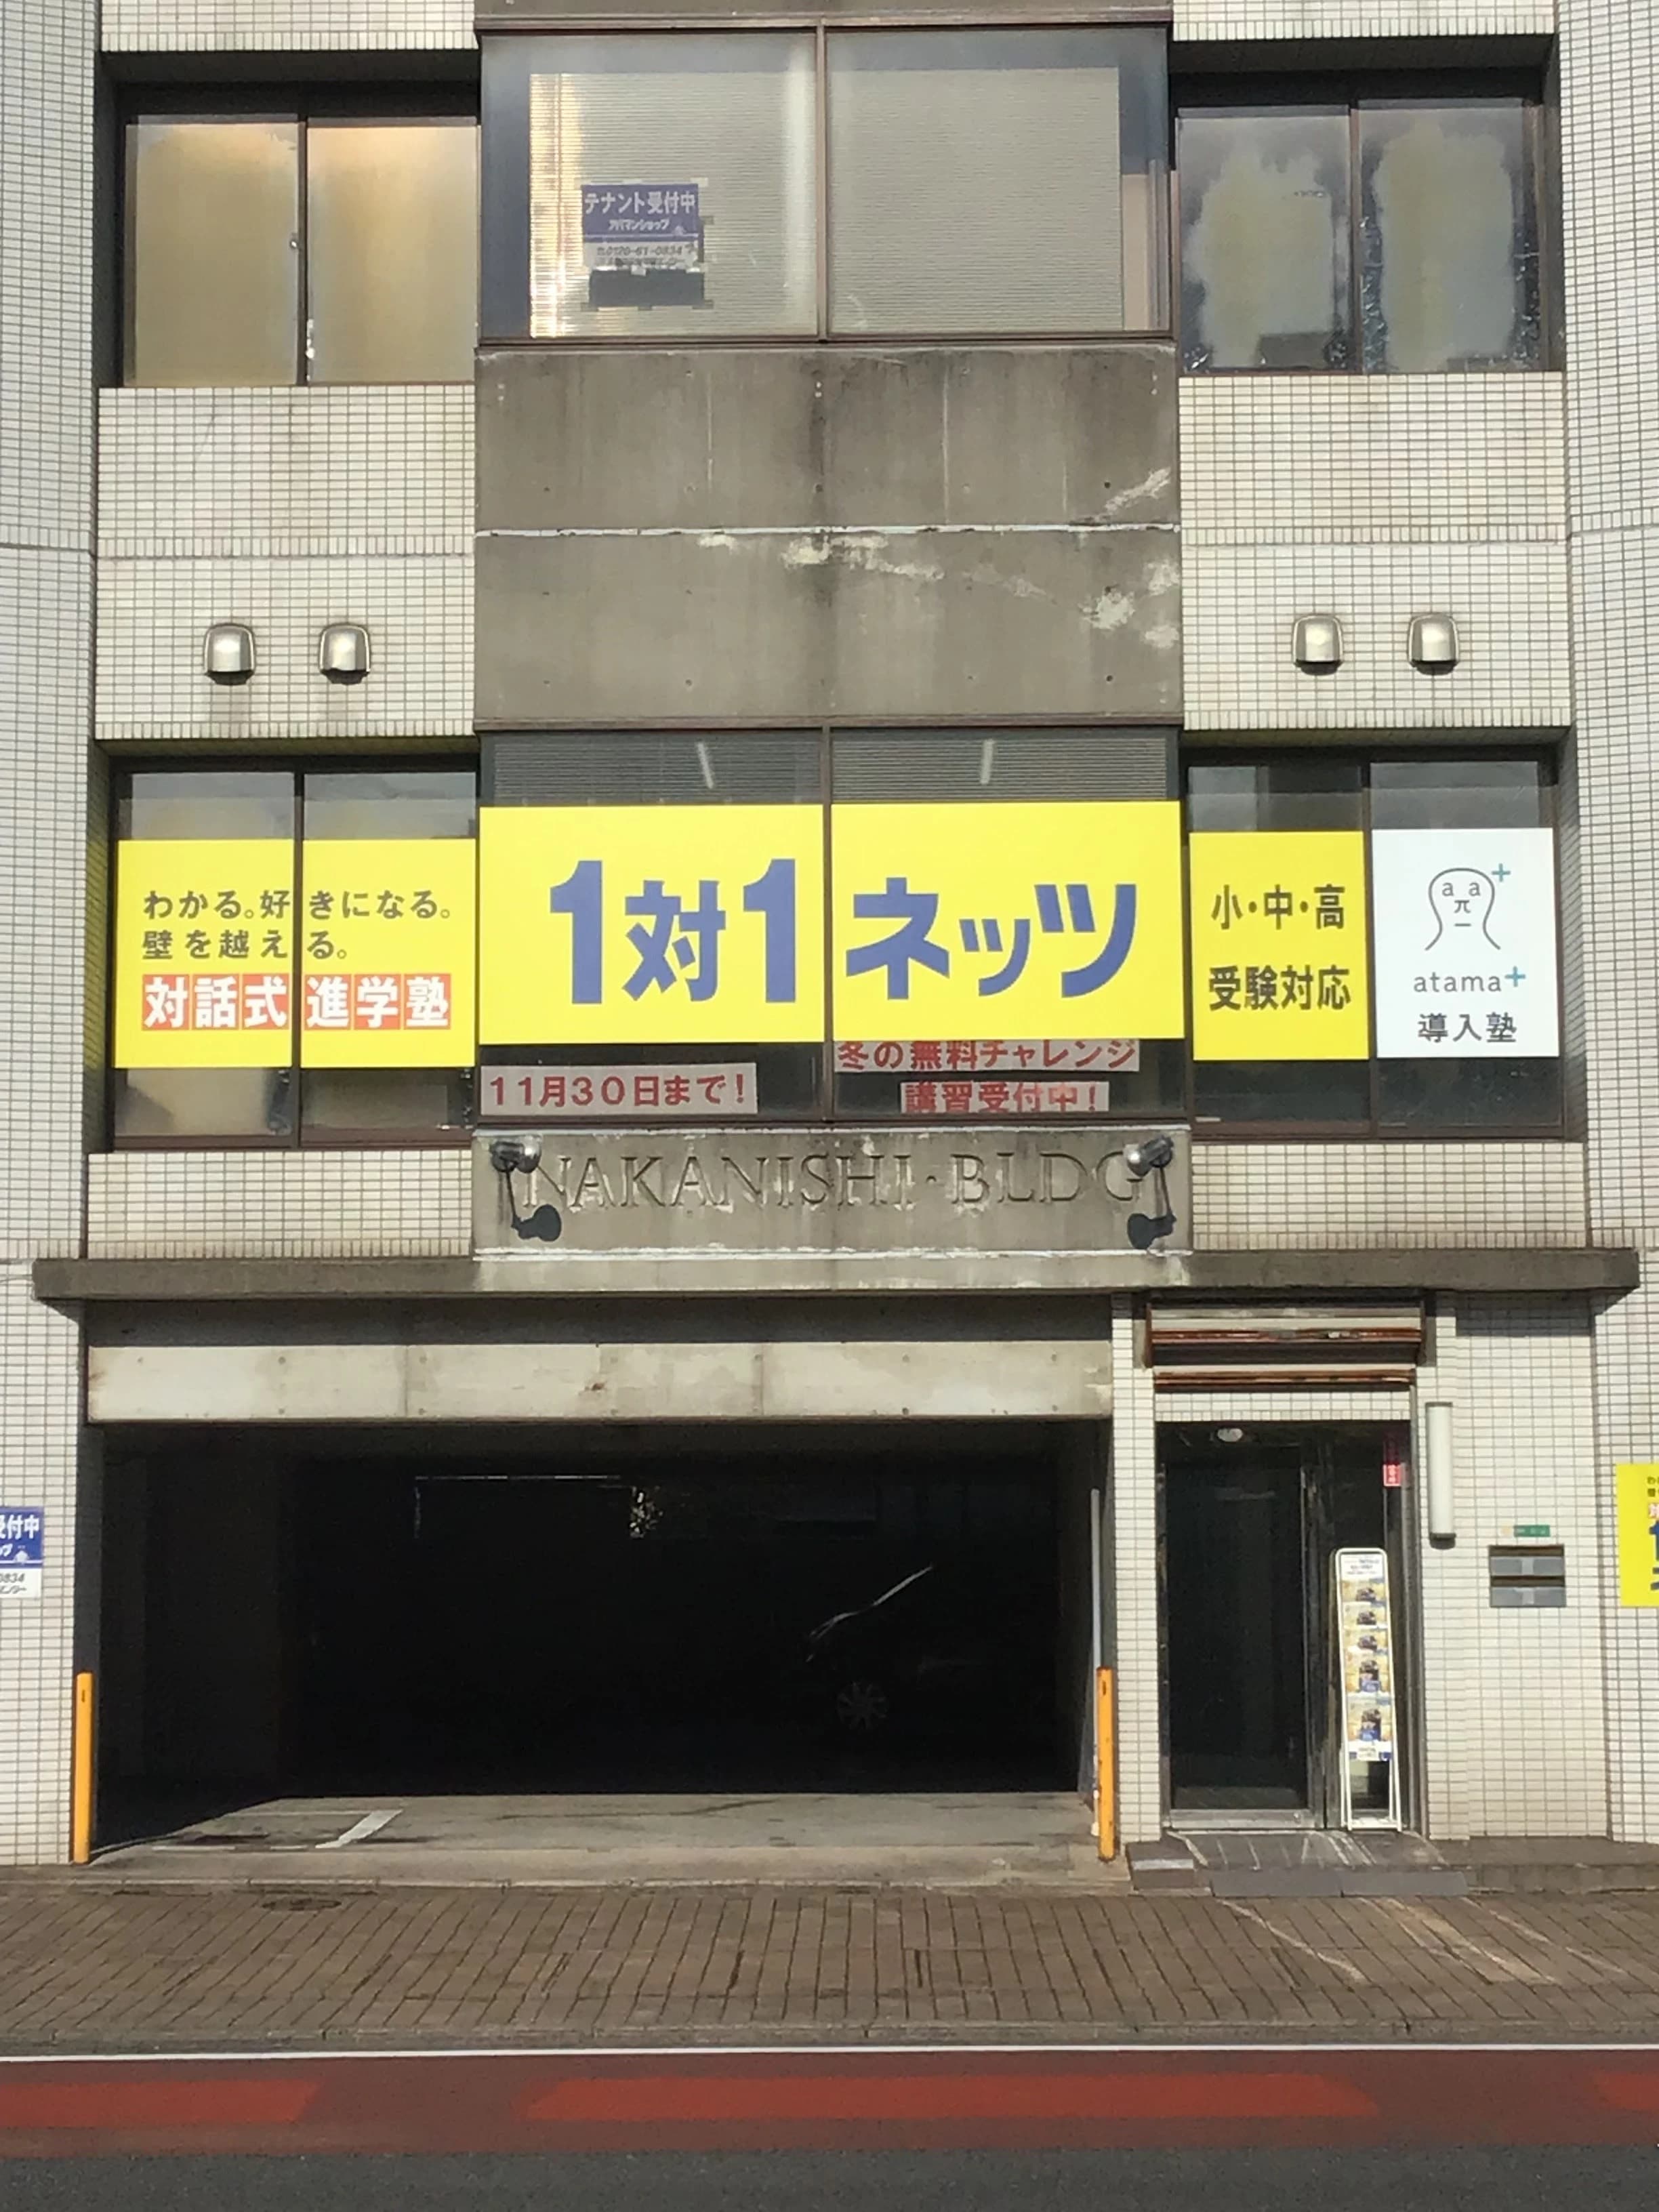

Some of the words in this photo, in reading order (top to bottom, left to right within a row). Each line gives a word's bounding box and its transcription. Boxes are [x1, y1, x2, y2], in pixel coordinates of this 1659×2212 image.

[584, 190, 696, 214] テナント受付中
[143, 890, 451, 920] わかる。好きになる。
[1211, 884, 1345, 930] 小・中・高
[142, 929, 347, 960] 壁を越える。
[144, 975, 450, 1028] 対話式進学塾
[1209, 964, 1351, 1010] 受験対応
[1418, 1012, 1517, 1043] 導入塾
[838, 1040, 1136, 1070] 冬の無料チャレンジ
